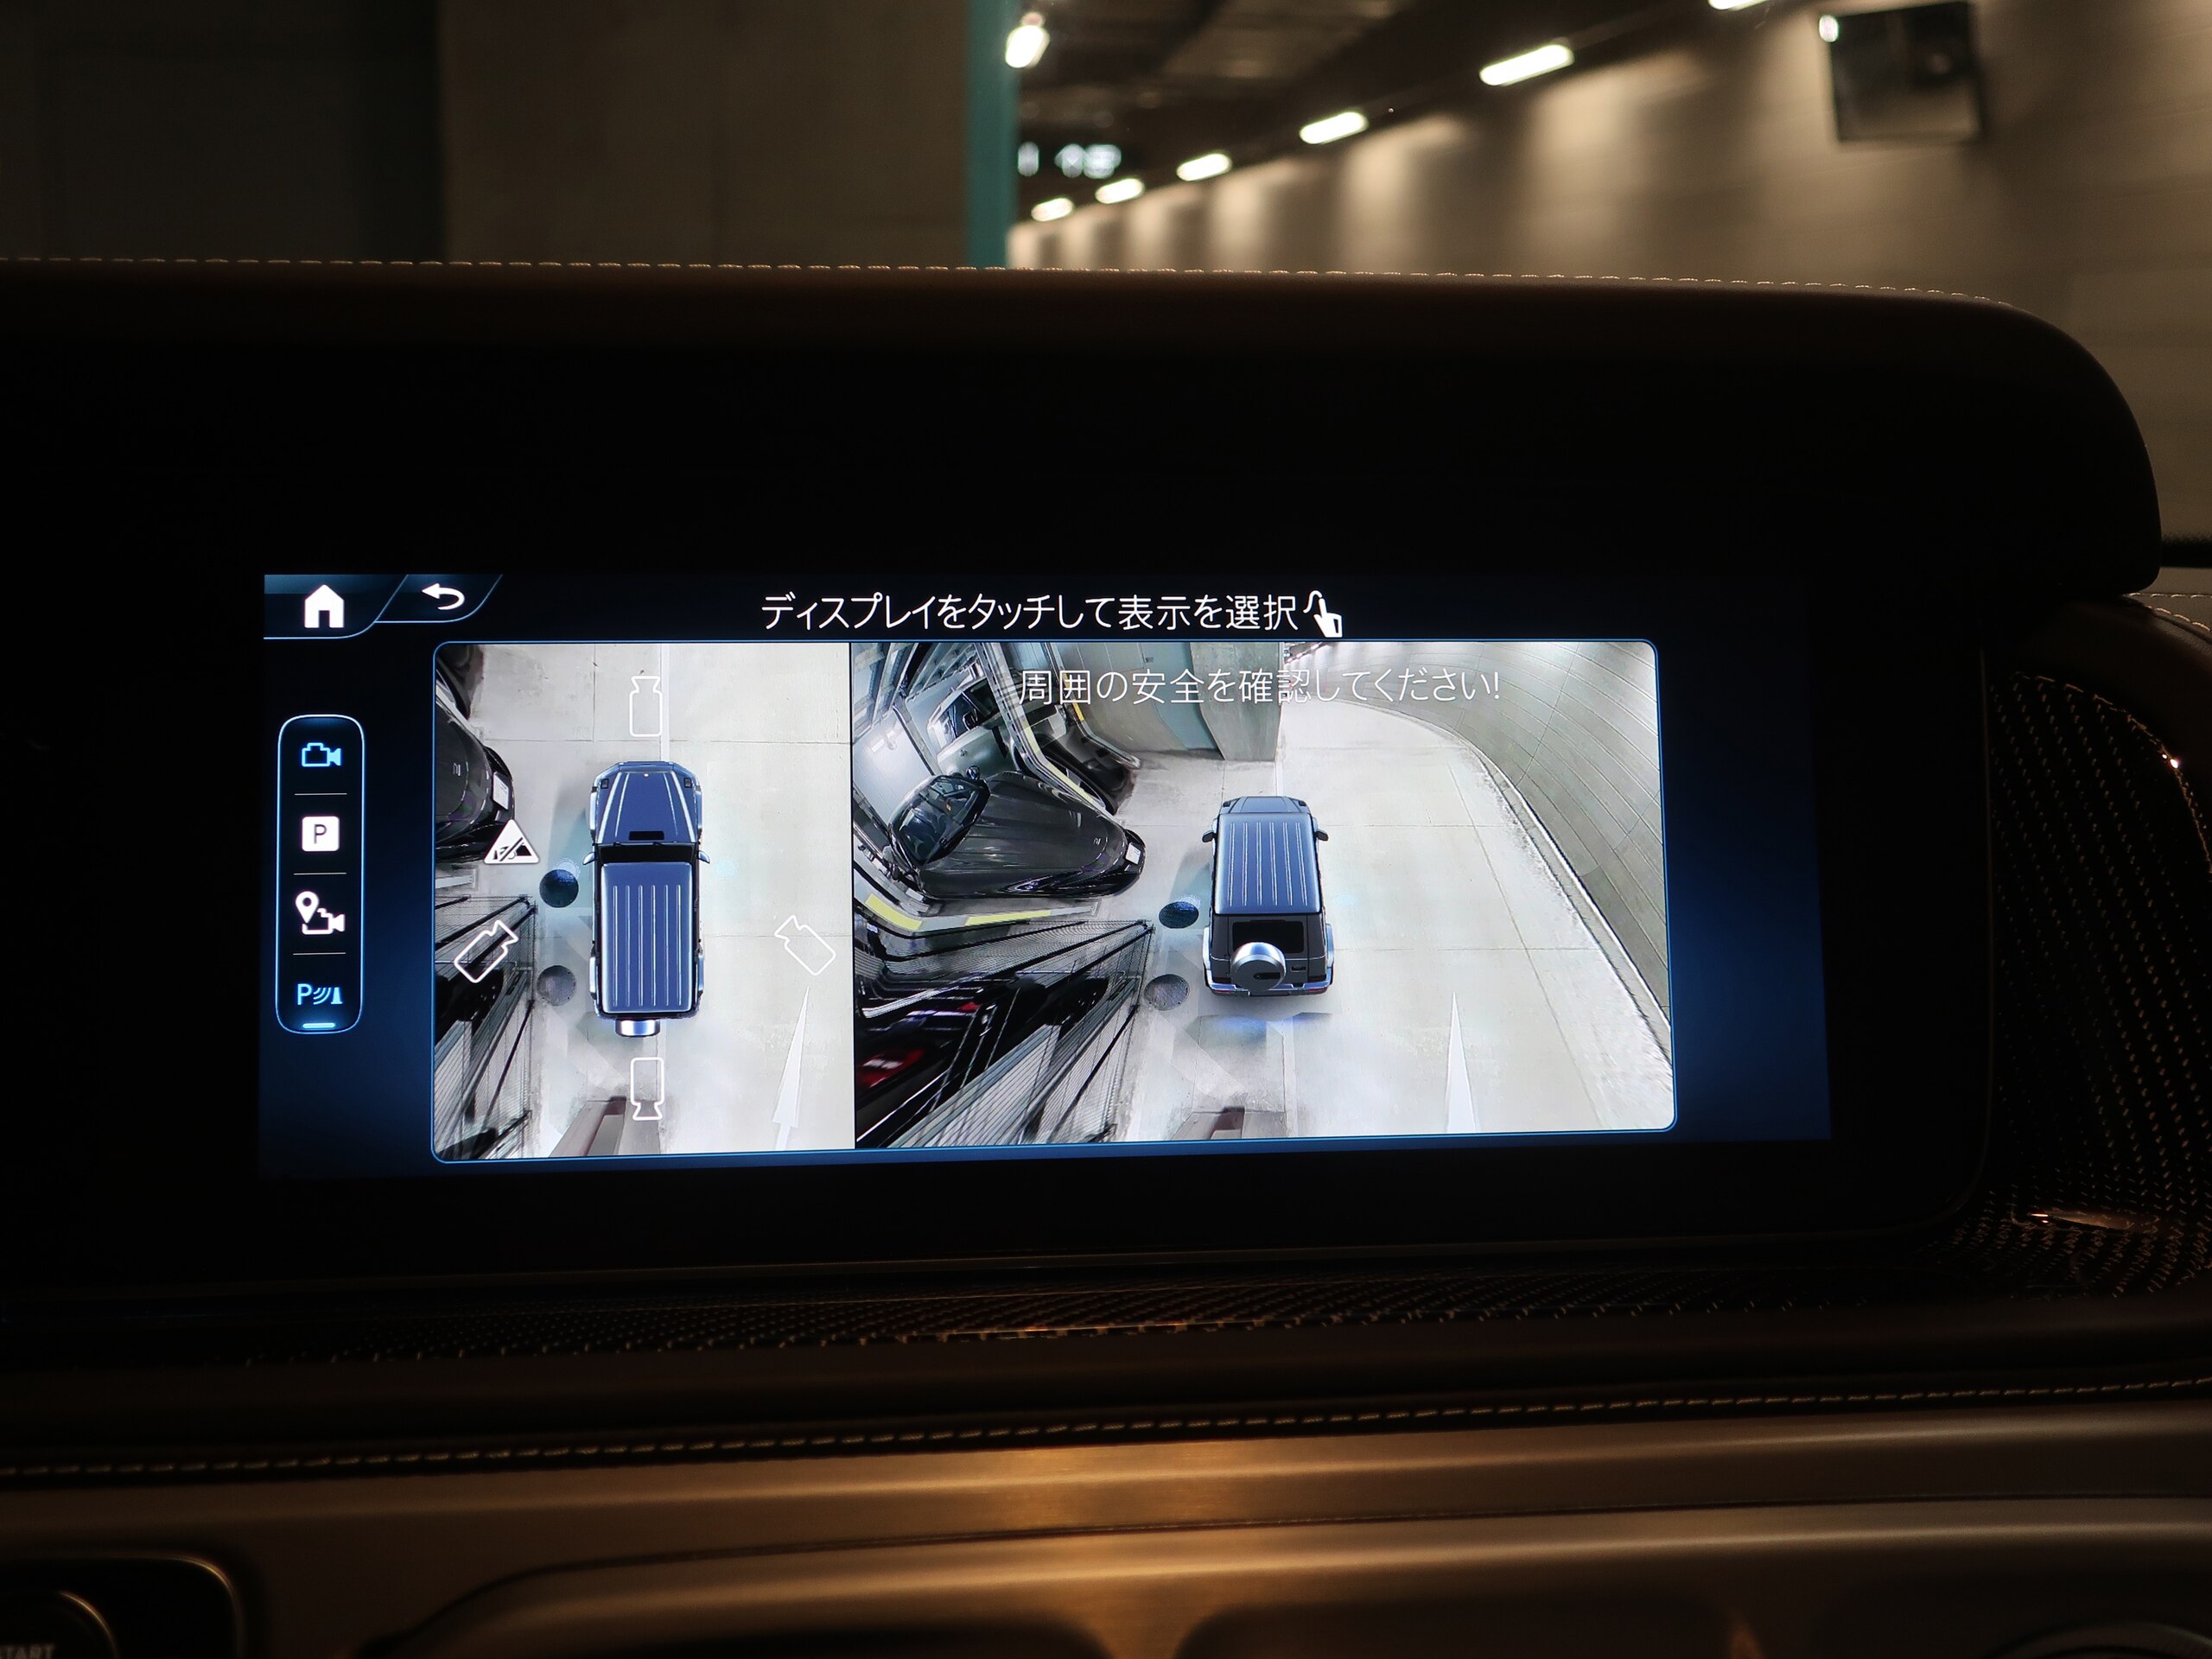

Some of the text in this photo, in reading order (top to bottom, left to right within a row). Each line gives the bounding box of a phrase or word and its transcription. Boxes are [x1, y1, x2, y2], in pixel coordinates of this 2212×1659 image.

[761, 591, 1299, 631] ディスプレイをタッチして表示を選択
[314, 823, 327, 844] P
